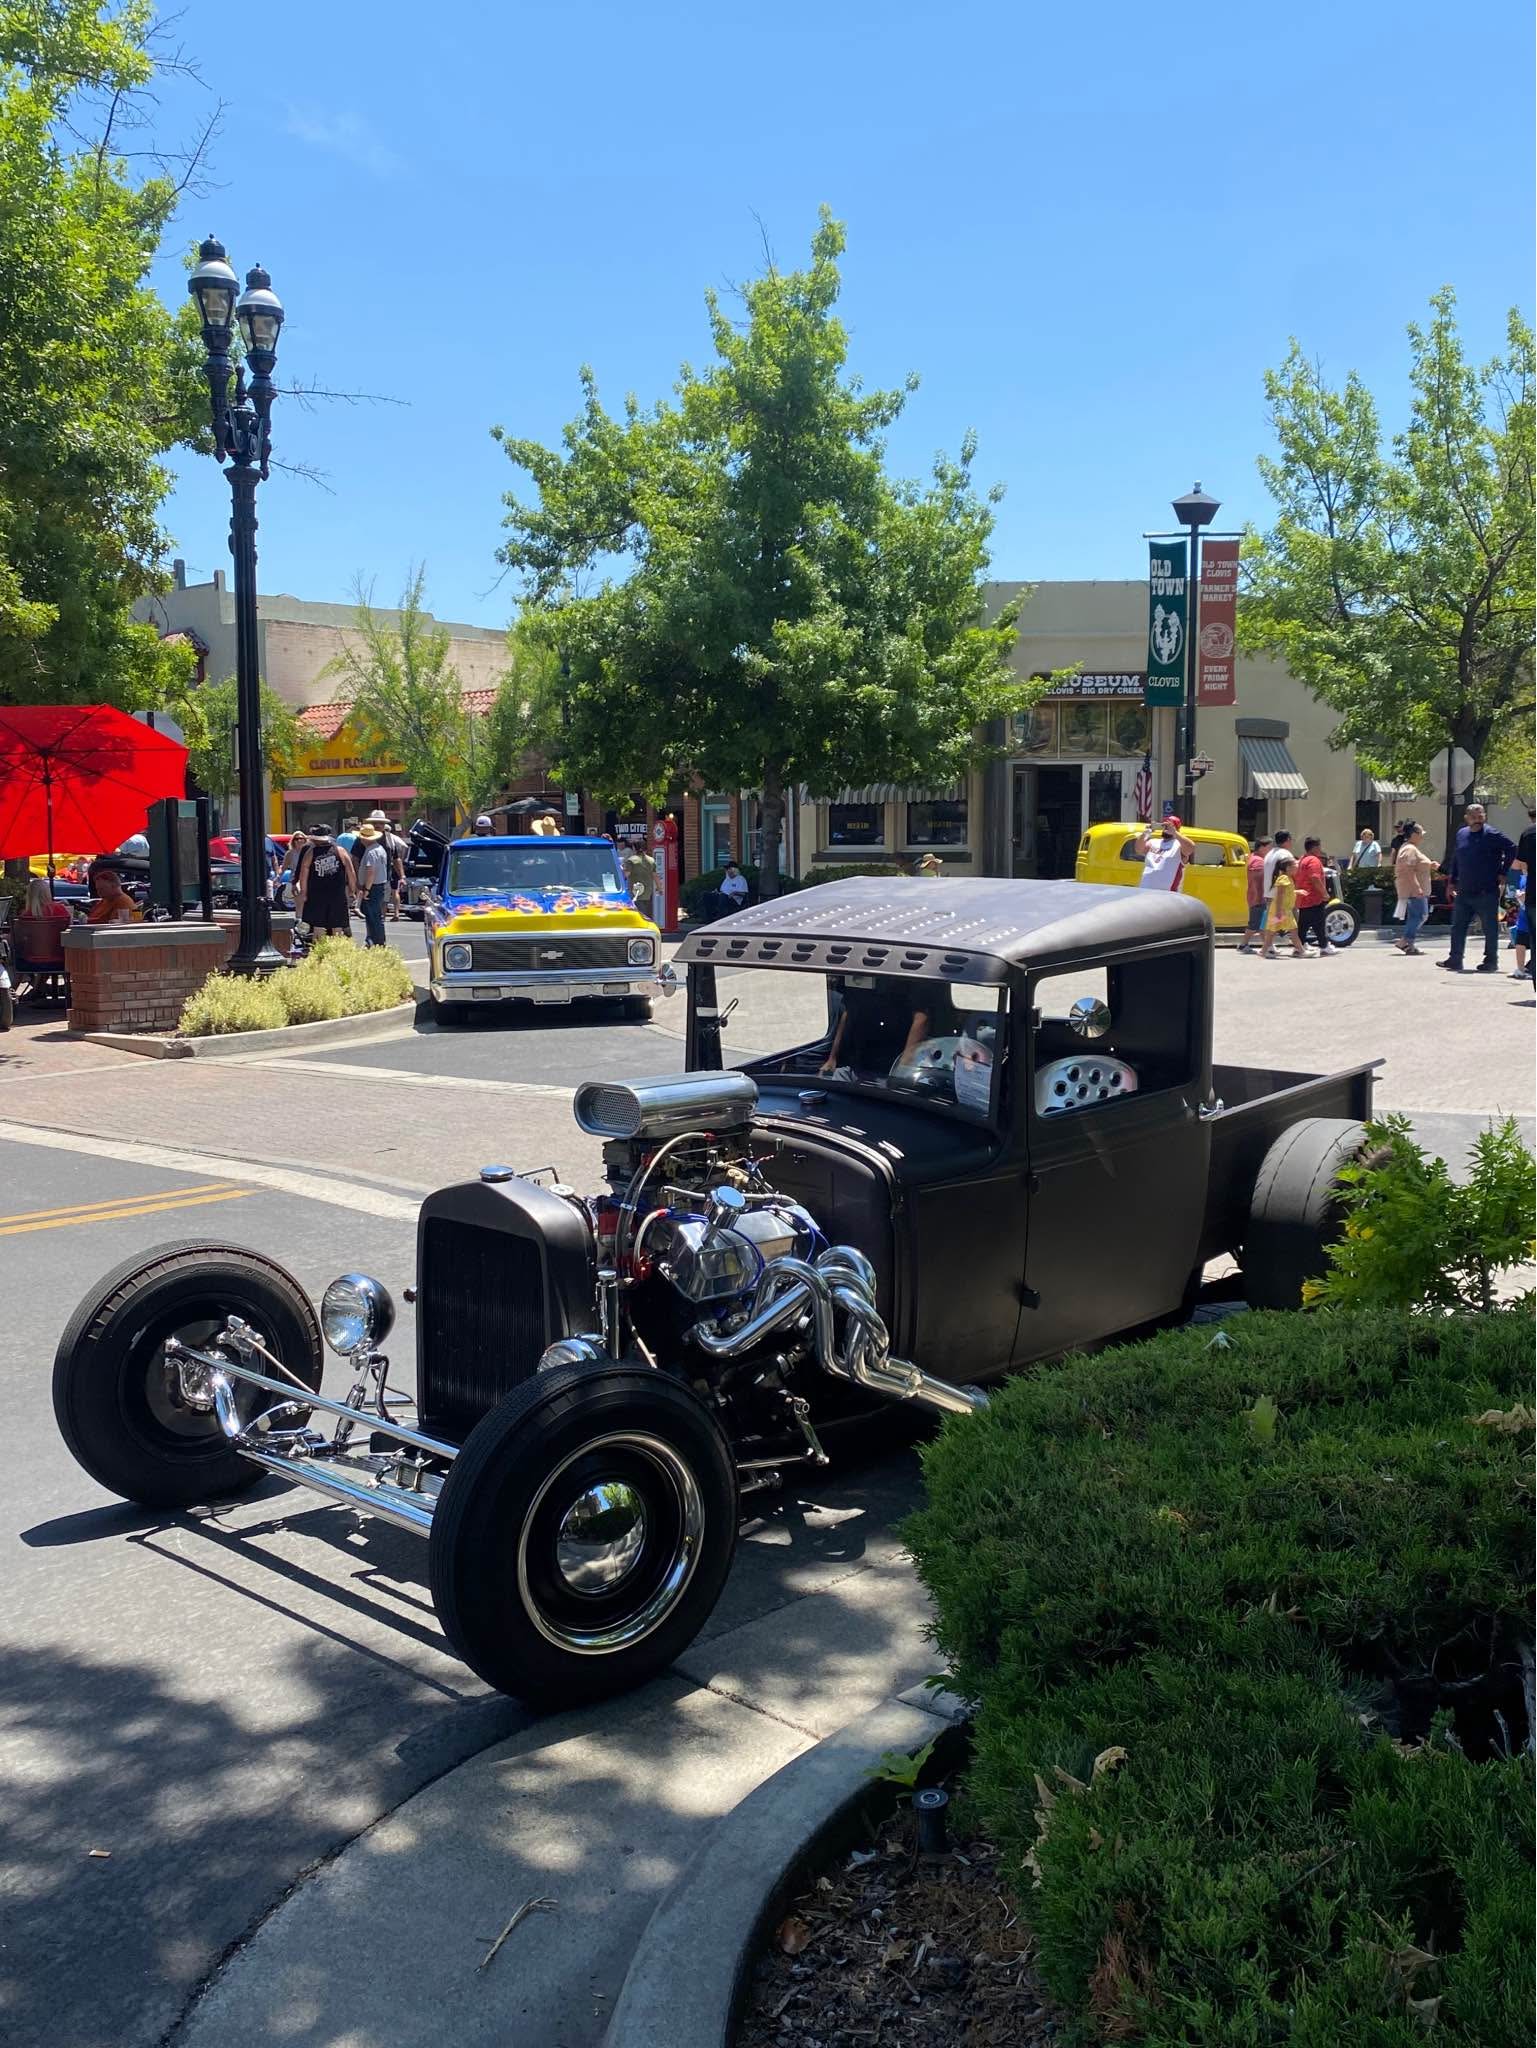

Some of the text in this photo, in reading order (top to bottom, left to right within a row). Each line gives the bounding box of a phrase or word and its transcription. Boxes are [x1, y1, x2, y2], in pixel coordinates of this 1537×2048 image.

[1151, 559, 1171, 577] OLD
[1217, 560, 1238, 568] TOWN
[1207, 569, 1232, 577] CLOVIS
[1151, 577, 1185, 596] TOWN
[1202, 593, 1233, 601] MARKET
[1204, 665, 1228, 673] EVERY
[1148, 676, 1180, 687] CLOVIS
[1203, 674, 1229, 682] FRIDAY
[614, 823, 648, 833] TWO CITIE
